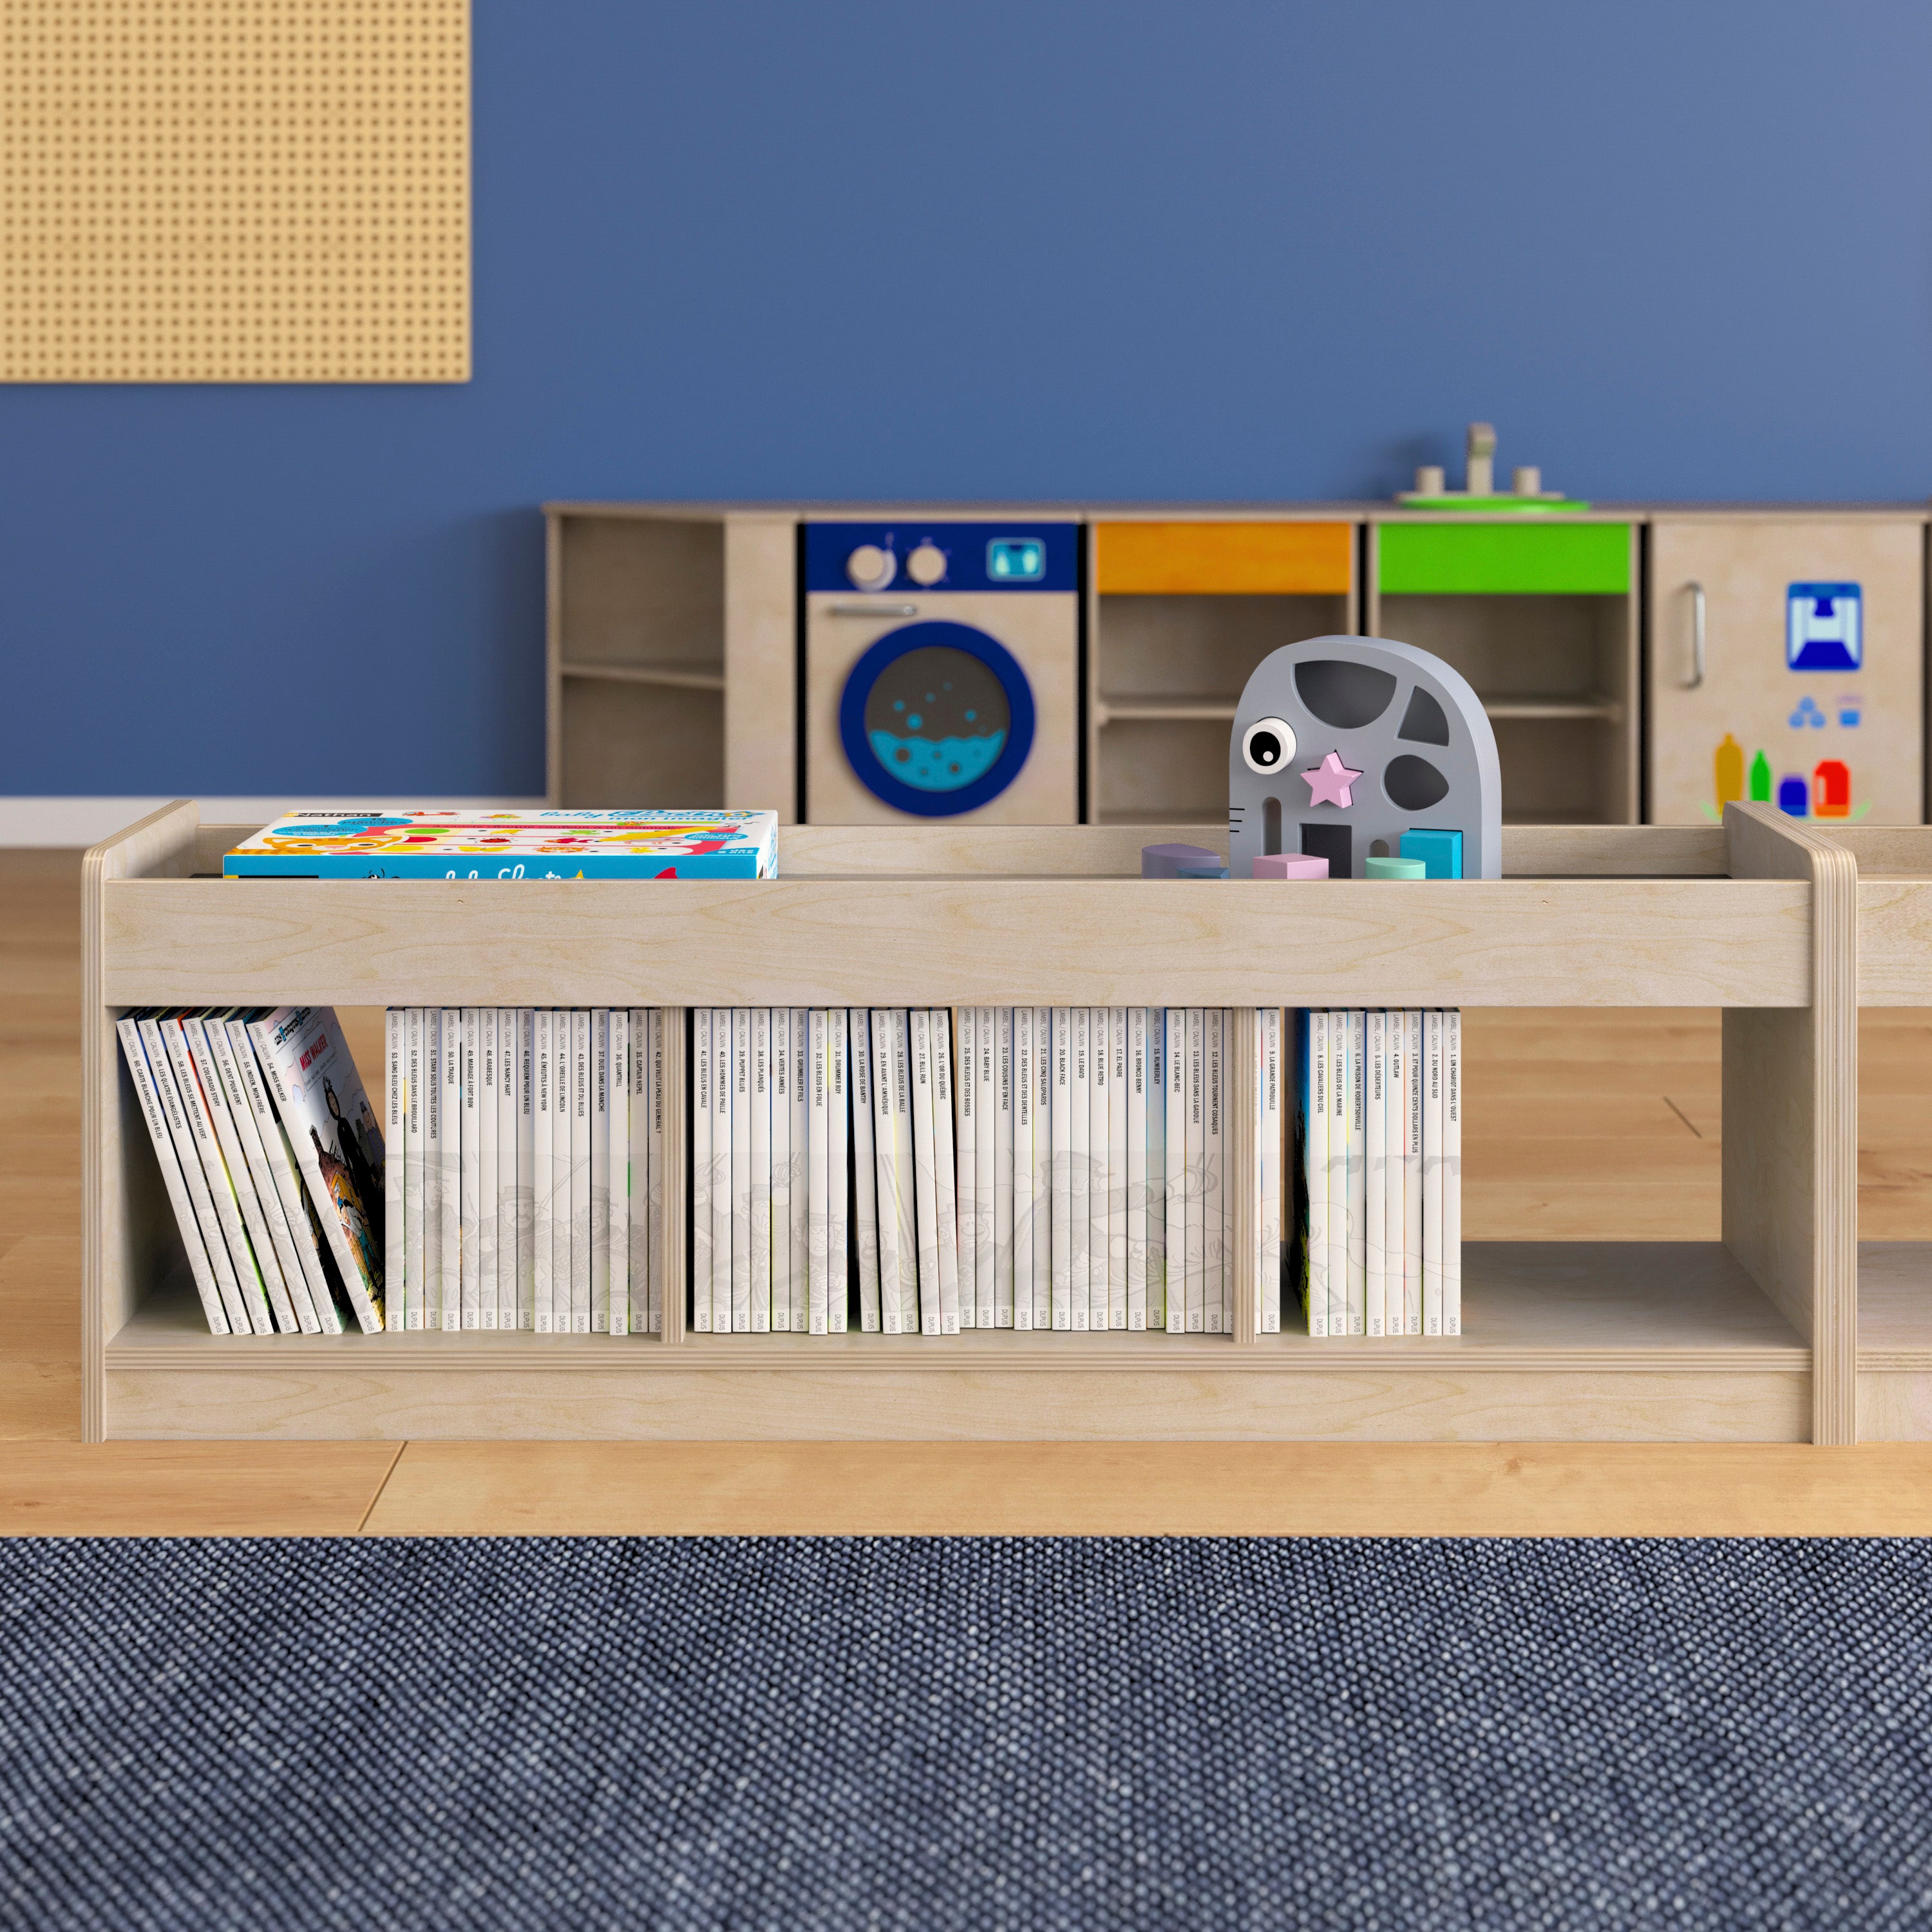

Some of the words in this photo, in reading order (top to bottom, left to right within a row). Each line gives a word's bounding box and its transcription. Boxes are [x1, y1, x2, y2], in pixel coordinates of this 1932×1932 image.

[299, 1050, 312, 1072] MISS
[309, 1033, 329, 1061] WALKER
[158, 1068, 166, 1078] LES
[188, 1020, 198, 1037] LAMBIL
[194, 1040, 204, 1057] CAUVIN
[202, 1066, 216, 1092] COLORADO
[211, 1092, 220, 1107] STORY
[136, 1068, 146, 1084] CARTE
[246, 1069, 256, 1088] INDIEN,
[140, 1083, 153, 1106] BLANCHE
[160, 1077, 172, 1097] QUATRE
[252, 1087, 260, 1099] MON
[270, 1070, 279, 1083] MISS
[275, 1083, 287, 1103] WALKER
[938, 1080, 947, 1099] QUÉBEC
[147, 1105, 156, 1119] POUR
[166, 1095, 182, 1130] ÉVANGÉLISTES
[255, 1099, 265, 1115] FRÈRE
[154, 1126, 163, 1139] BLEU
[213, 1316, 223, 1333] DUPUIS
